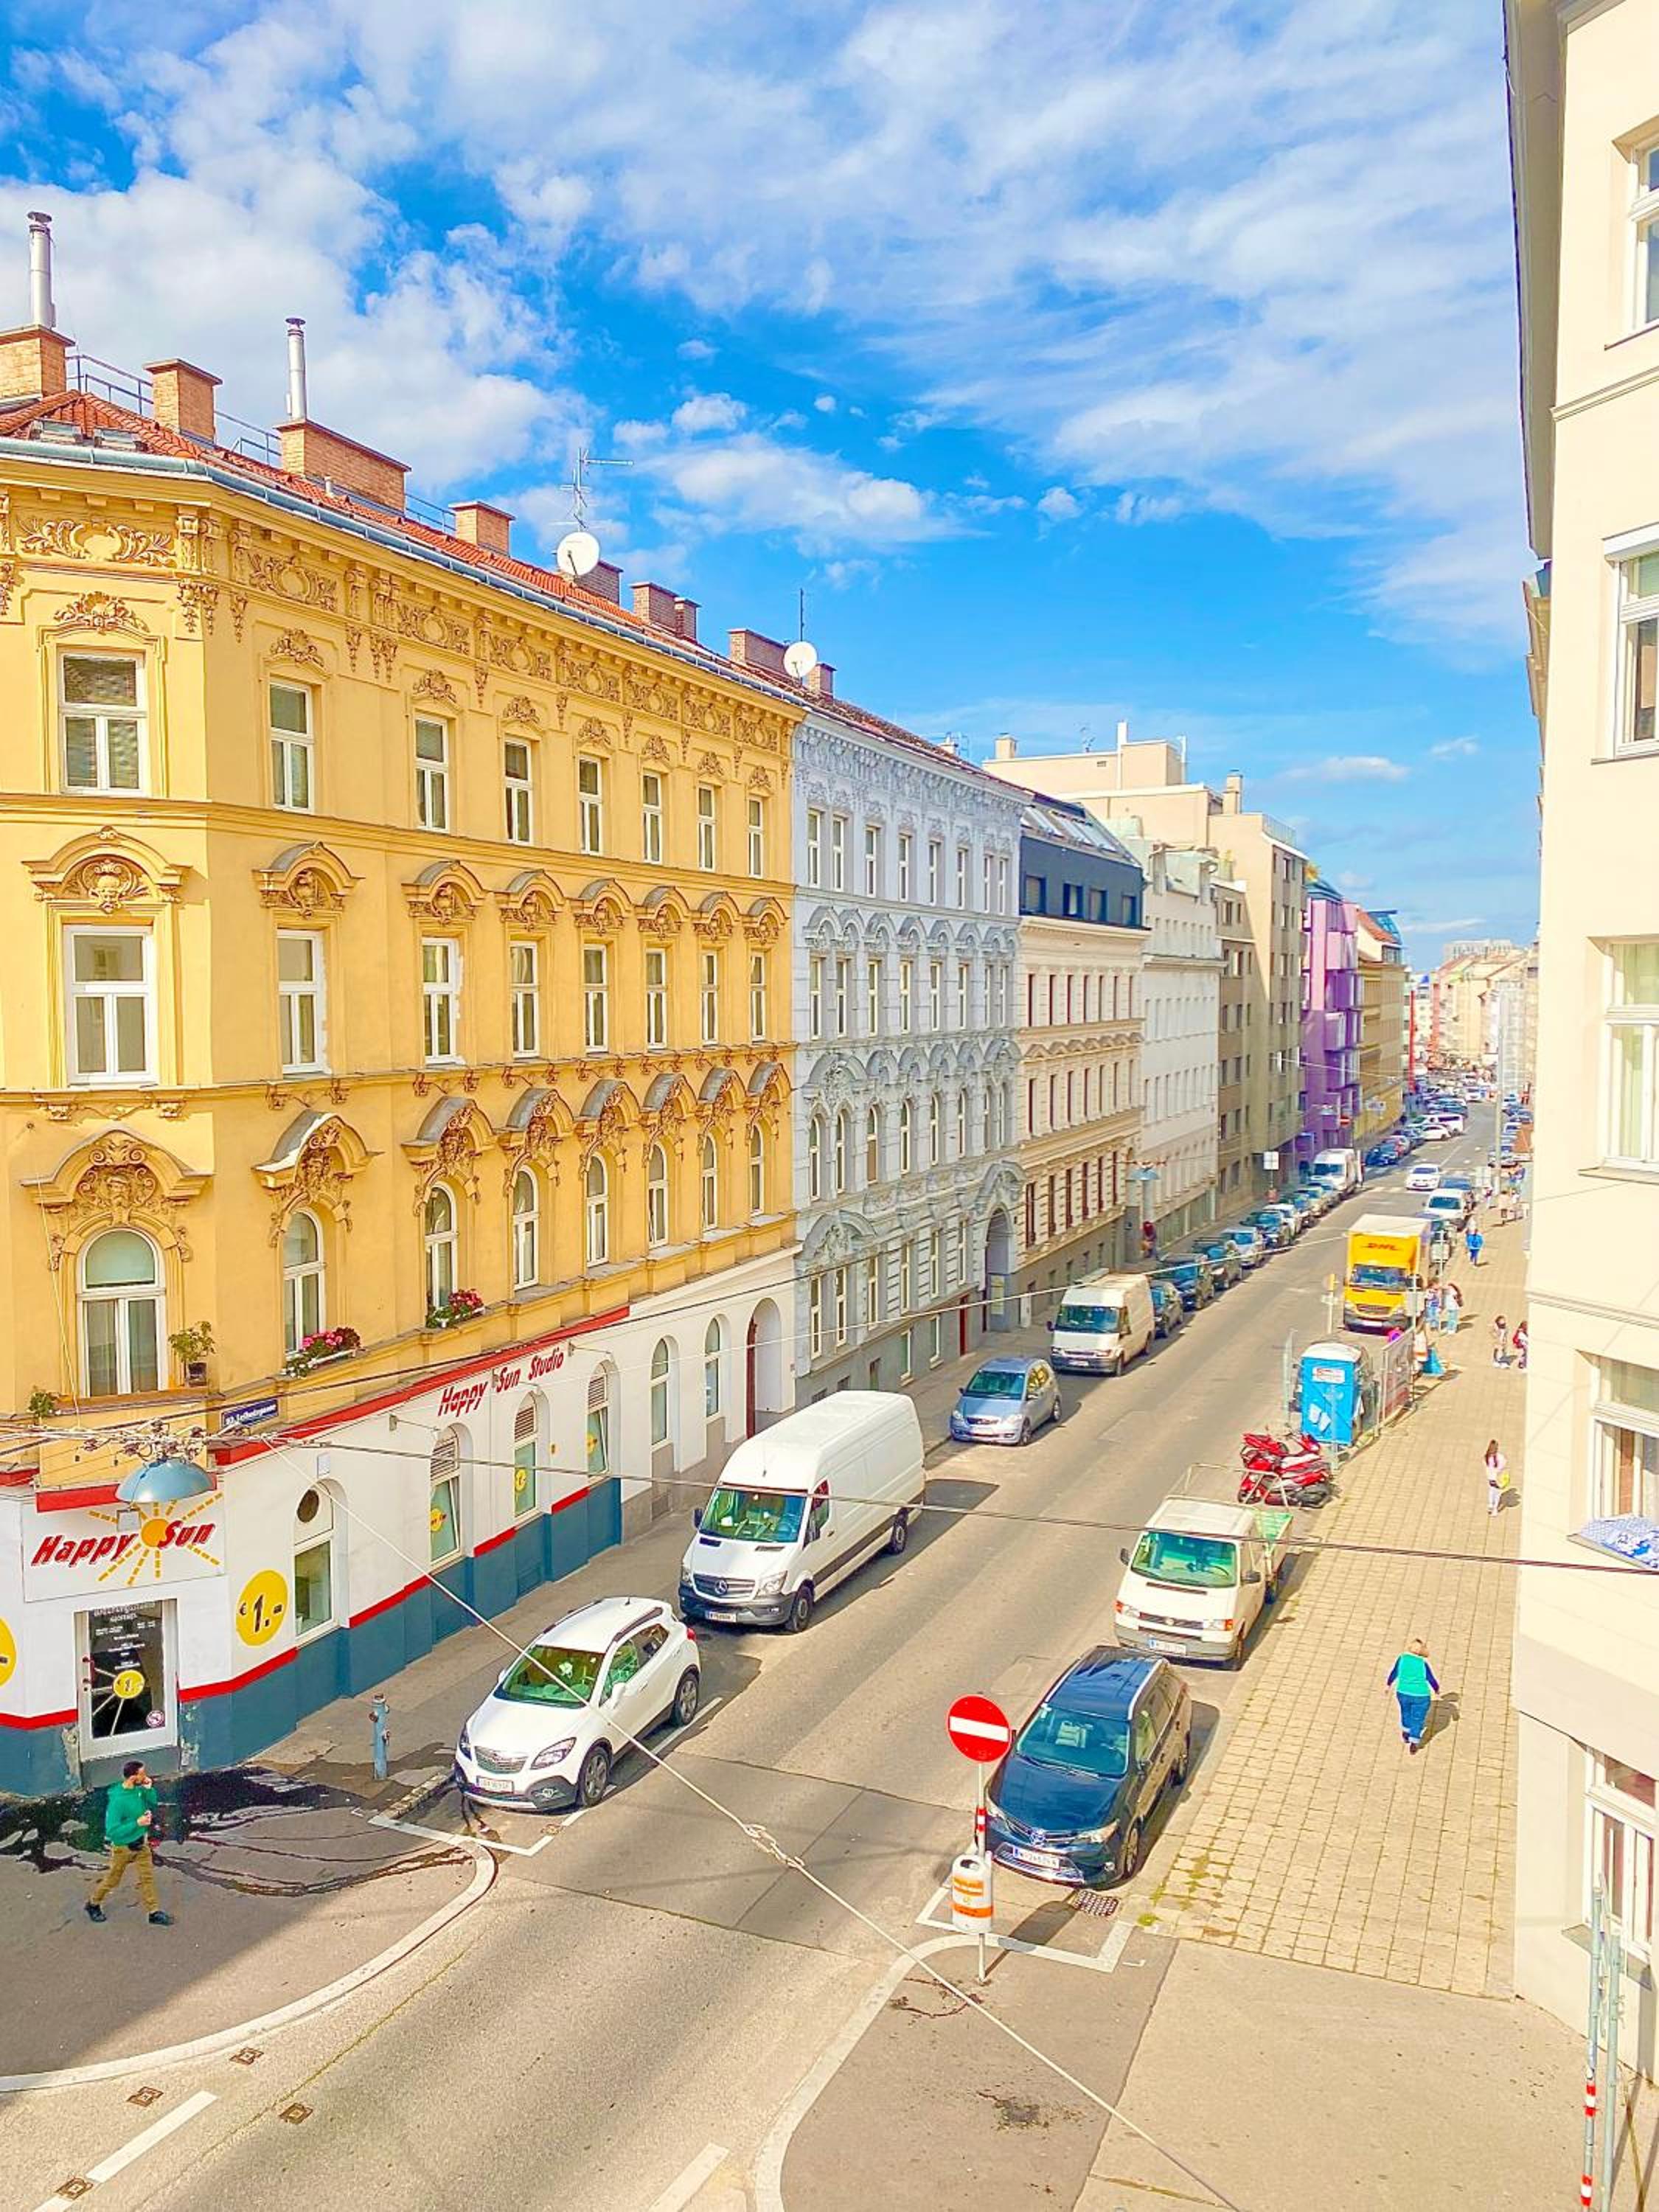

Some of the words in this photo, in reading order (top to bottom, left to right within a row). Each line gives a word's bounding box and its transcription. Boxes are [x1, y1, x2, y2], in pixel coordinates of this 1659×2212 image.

[1367, 1242, 1399, 1251] DHL
[437, 1381, 489, 1417] Happy
[496, 1367, 521, 1393] Sun
[527, 1347, 564, 1381] Studio
[30, 1533, 139, 1568] Happy
[156, 1520, 216, 1550] Sun
